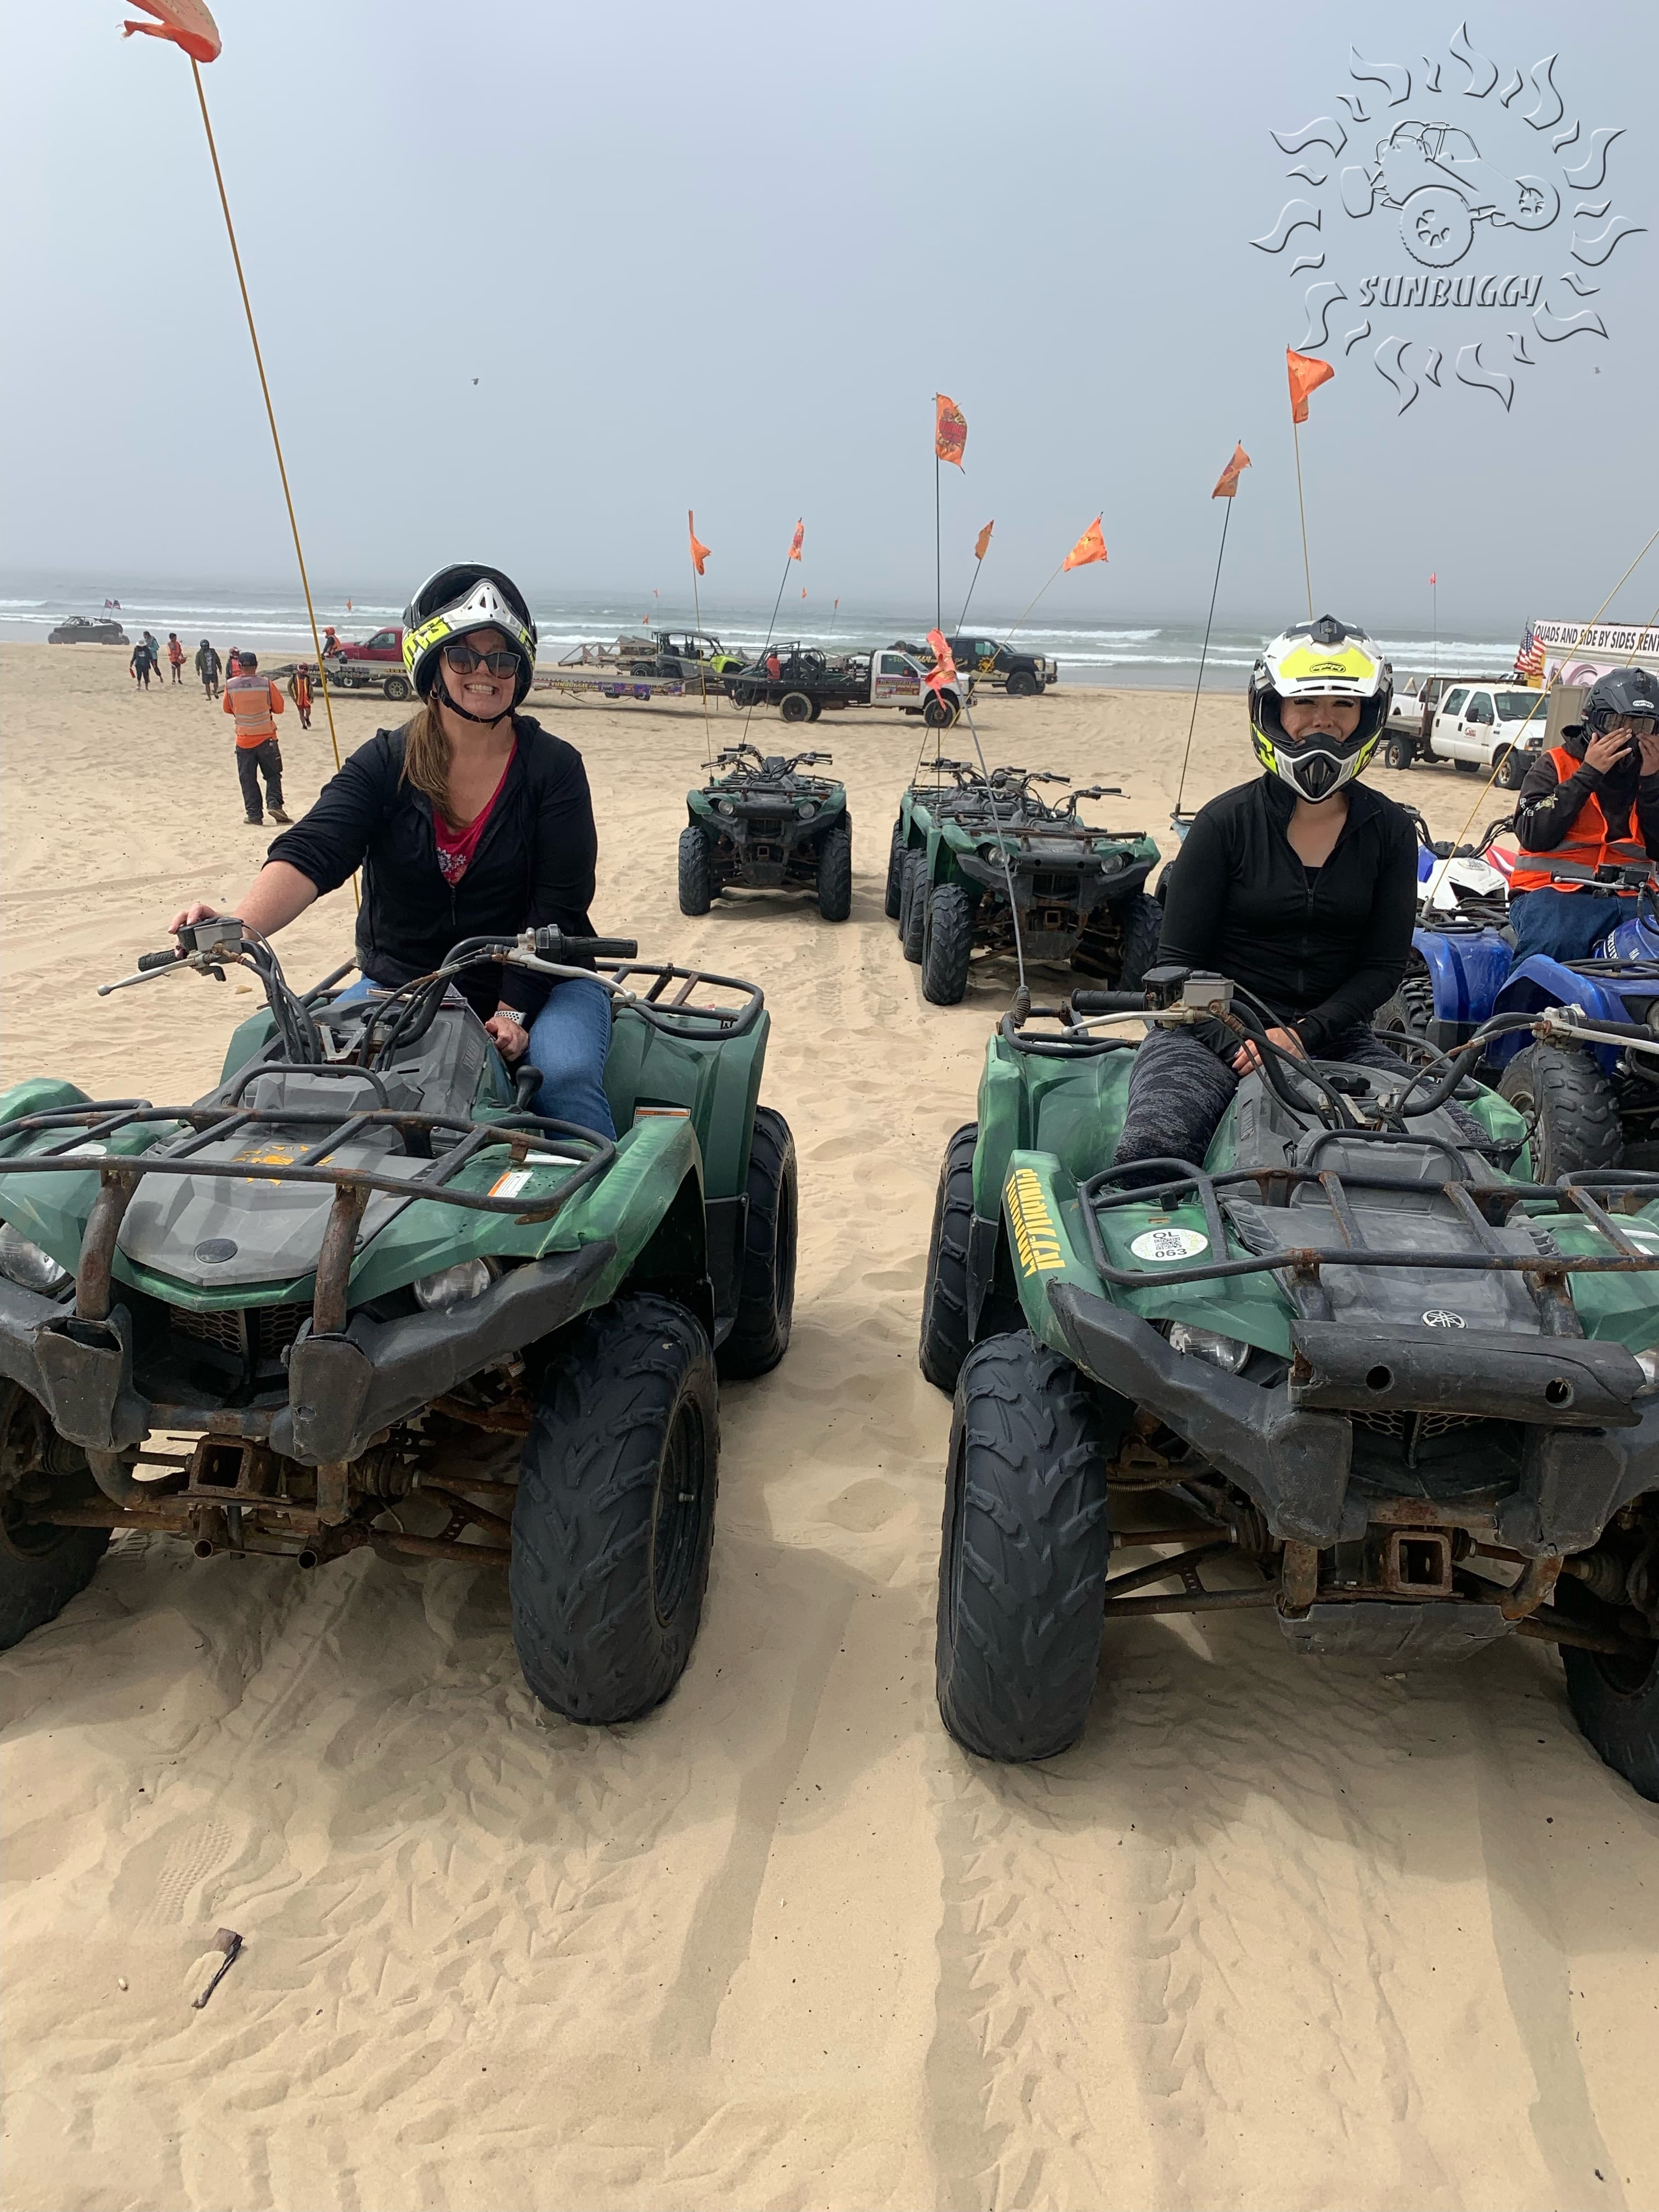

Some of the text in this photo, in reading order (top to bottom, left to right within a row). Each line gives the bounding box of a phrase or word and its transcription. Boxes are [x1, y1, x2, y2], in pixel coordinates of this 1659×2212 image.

[1536, 625, 1560, 642] QUADS
[1560, 628, 1577, 644] AND
[1579, 629, 1598, 646] SIDE
[1598, 630, 1611, 647] BY
[1610, 631, 1636, 650] SIDES
[1155, 1248, 1187, 1257] 063
